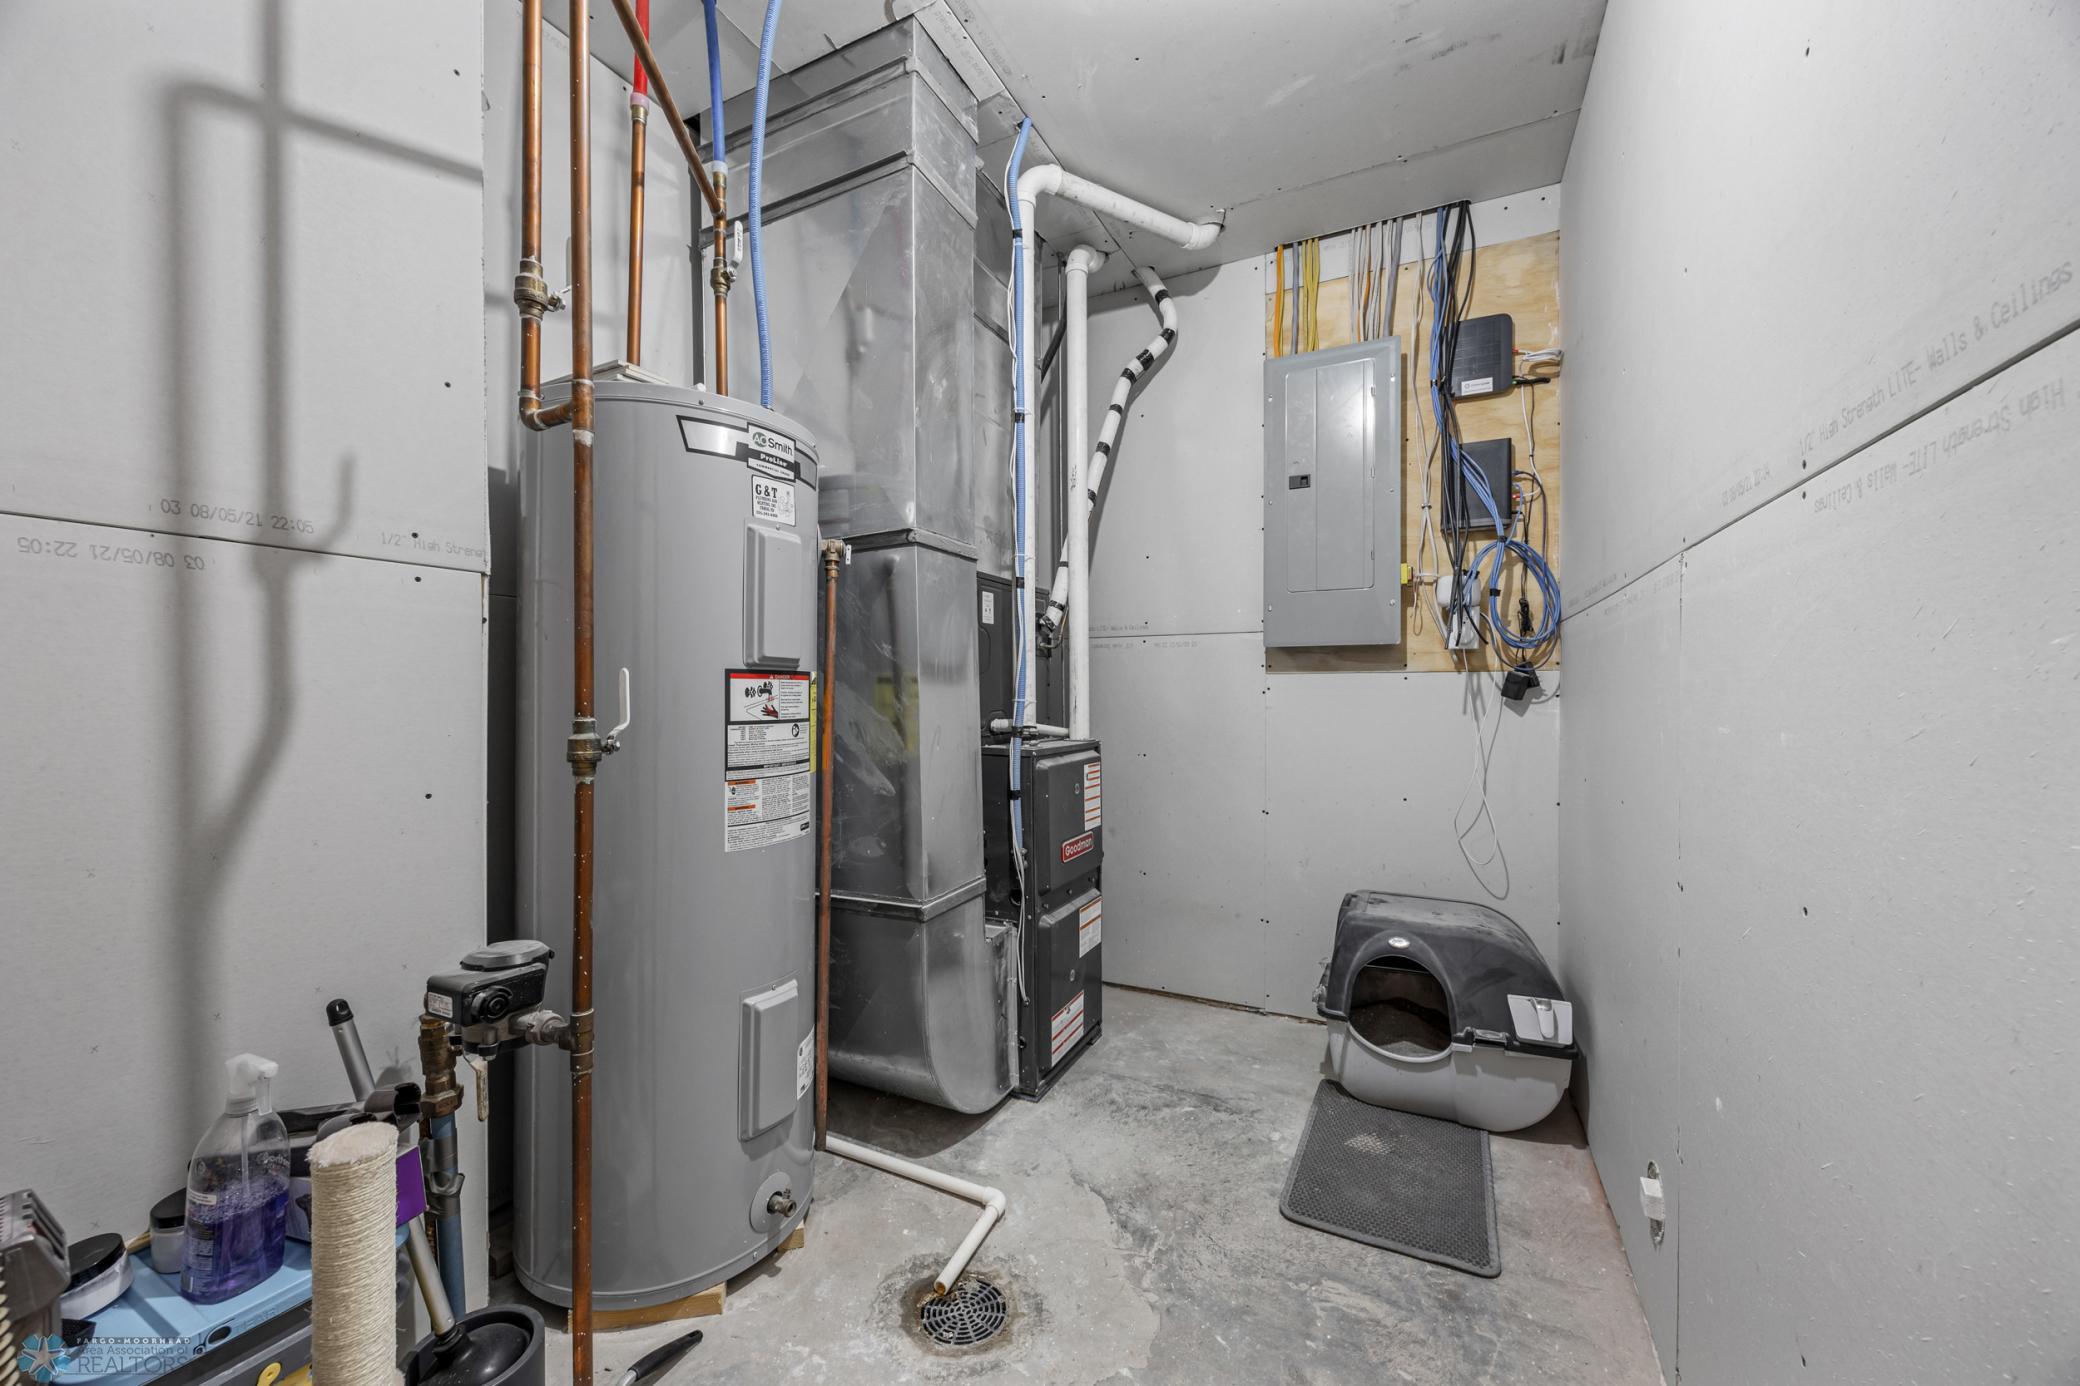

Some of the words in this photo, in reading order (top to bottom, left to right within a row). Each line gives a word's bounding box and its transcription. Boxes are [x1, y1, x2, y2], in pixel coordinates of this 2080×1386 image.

[1927, 331, 1969, 367] Walls
[1972, 315, 1985, 341] &
[1990, 261, 2073, 329] Ceilings
[768, 437, 793, 456] Smith
[764, 485, 770, 497] &
[771, 487, 778, 499] T
[160, 498, 182, 516] 03
[190, 503, 264, 529] 08/05/21
[271, 514, 316, 535] 22:05
[17, 535, 78, 559] 22:05
[89, 543, 175, 569] 08/05/21
[184, 554, 205, 571] 03
[1065, 837, 1093, 857] Goodman
